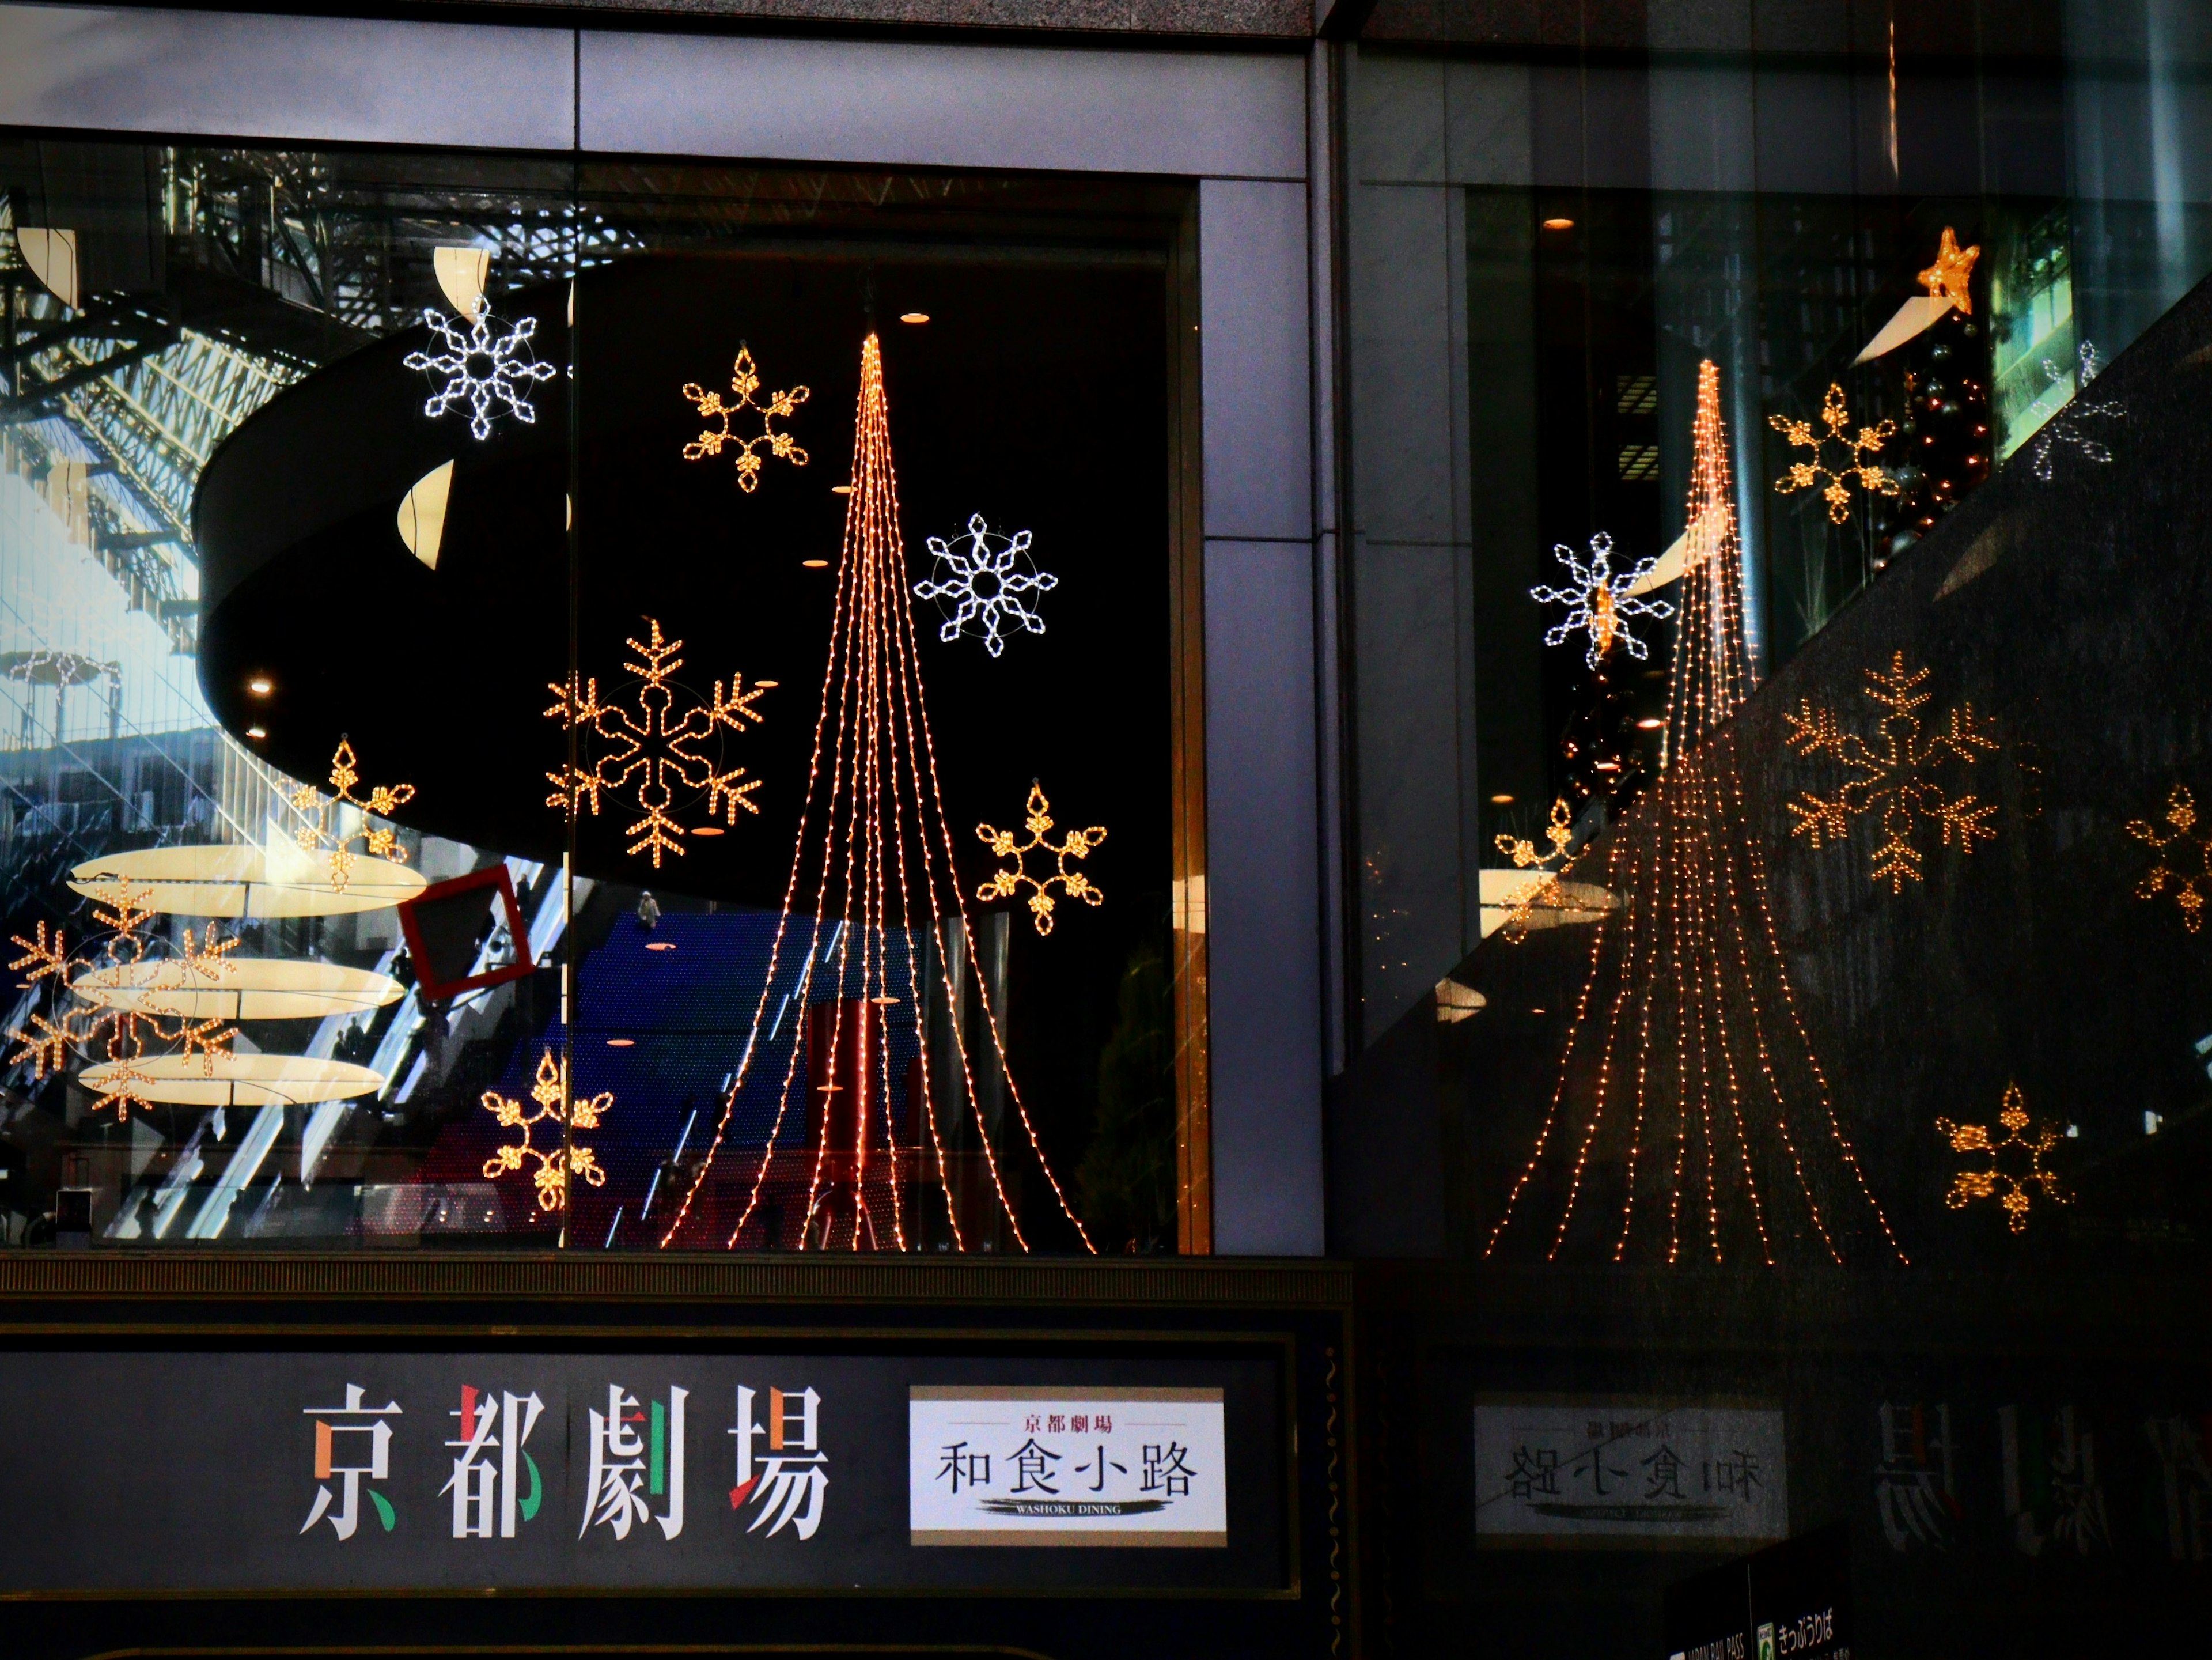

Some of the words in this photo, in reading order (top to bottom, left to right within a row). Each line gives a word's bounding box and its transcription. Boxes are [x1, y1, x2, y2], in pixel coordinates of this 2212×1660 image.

[1024, 1414, 1113, 1434] 京都劇場
[298, 1383, 830, 1541] 京都劇場
[935, 1438, 1198, 1497] 和食小路
[1016, 1504, 1075, 1515] WASHOKU
[1078, 1504, 1121, 1515] DINING
[1726, 1632, 1745, 1660] PASS
[1779, 1607, 1833, 1654] きっぷうりば
